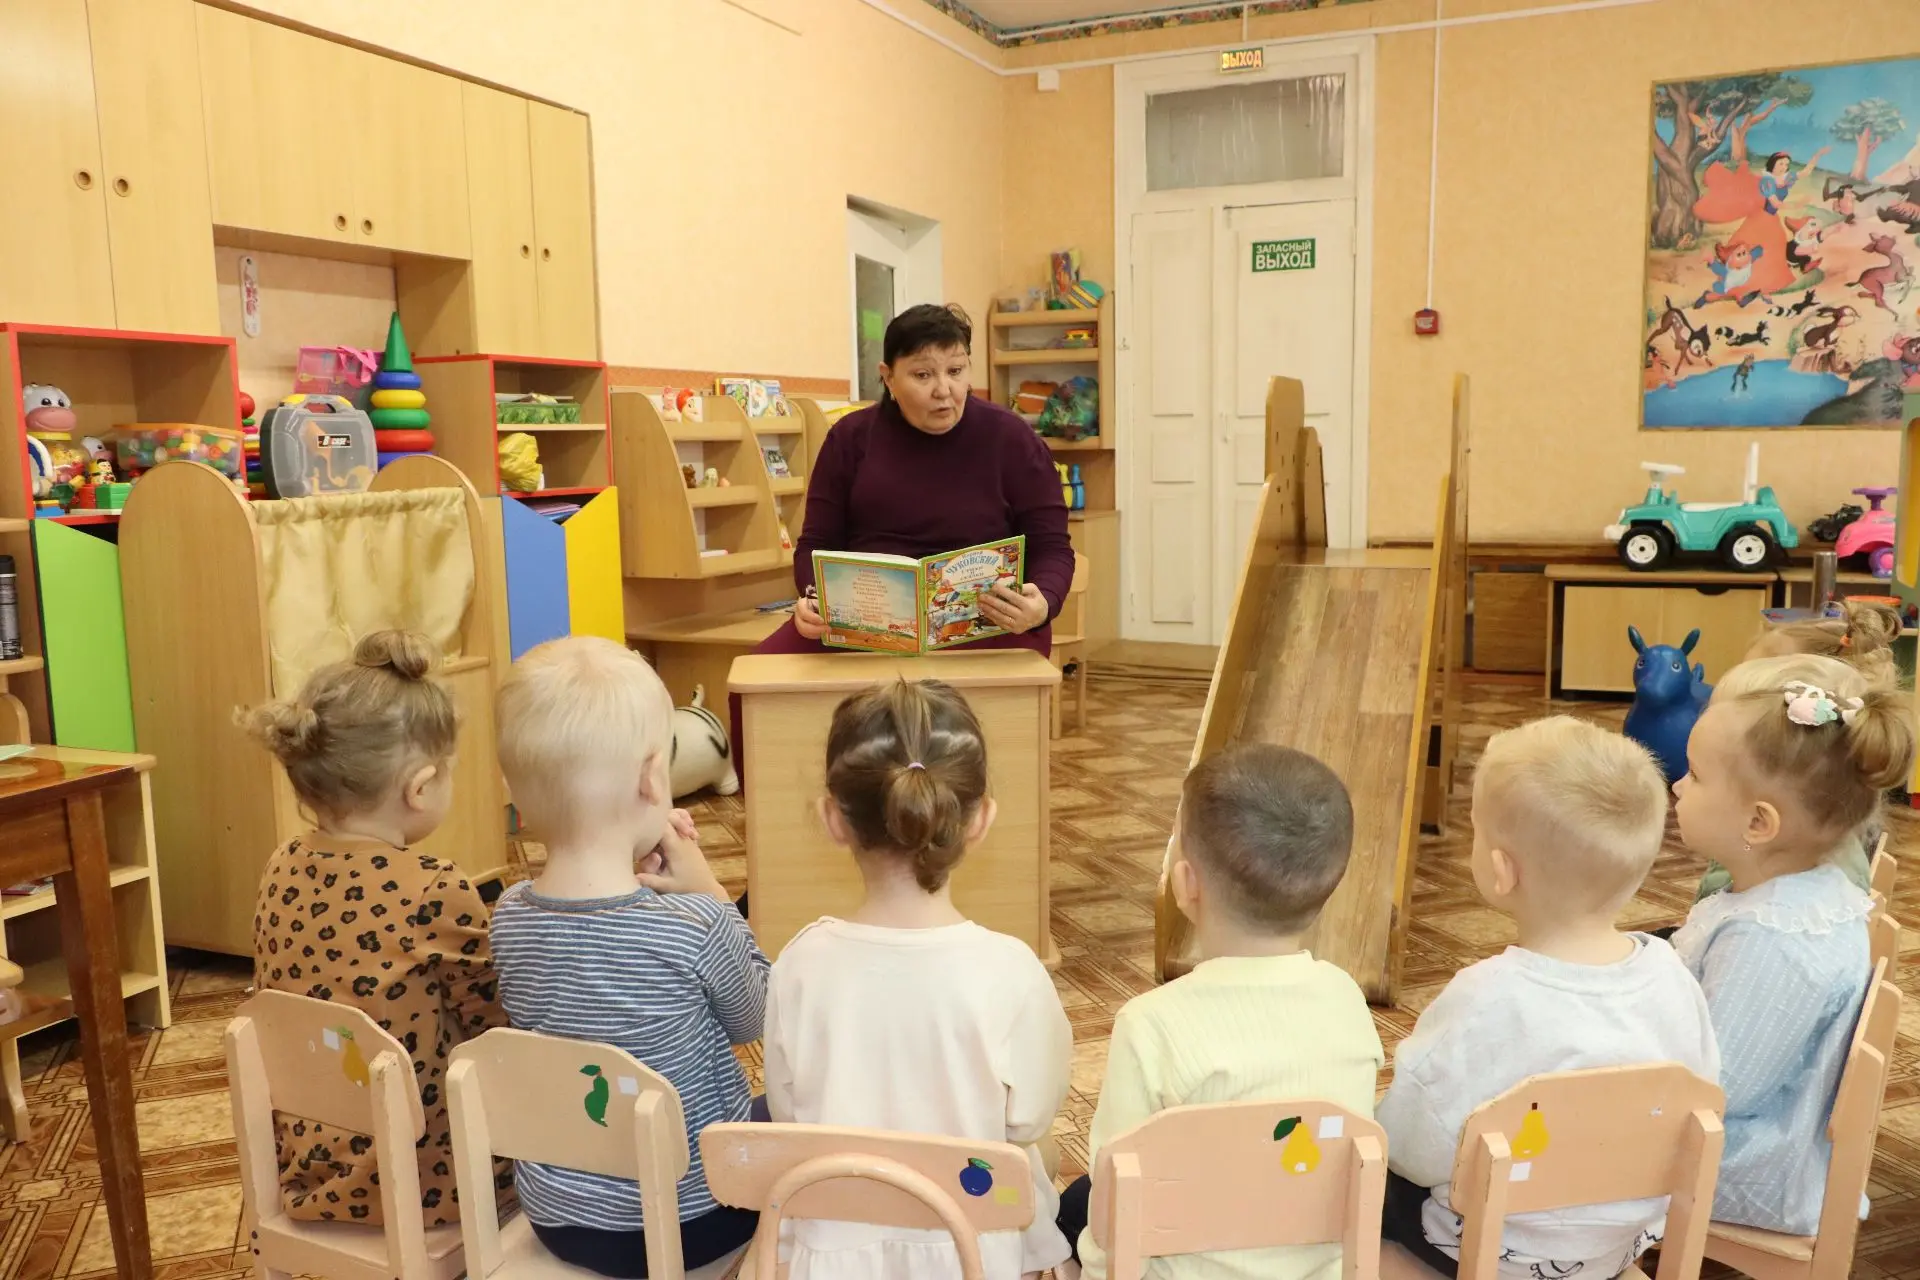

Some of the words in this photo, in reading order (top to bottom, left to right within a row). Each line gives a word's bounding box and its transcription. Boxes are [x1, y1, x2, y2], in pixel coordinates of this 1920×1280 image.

[1222, 50, 1263, 68] ВЫХОД
[1256, 240, 1311, 254] ЗАПАСНЫЙ
[1256, 251, 1311, 269] ВЫХОД
[946, 555, 1000, 574] ЧУКОВСКИЙ
